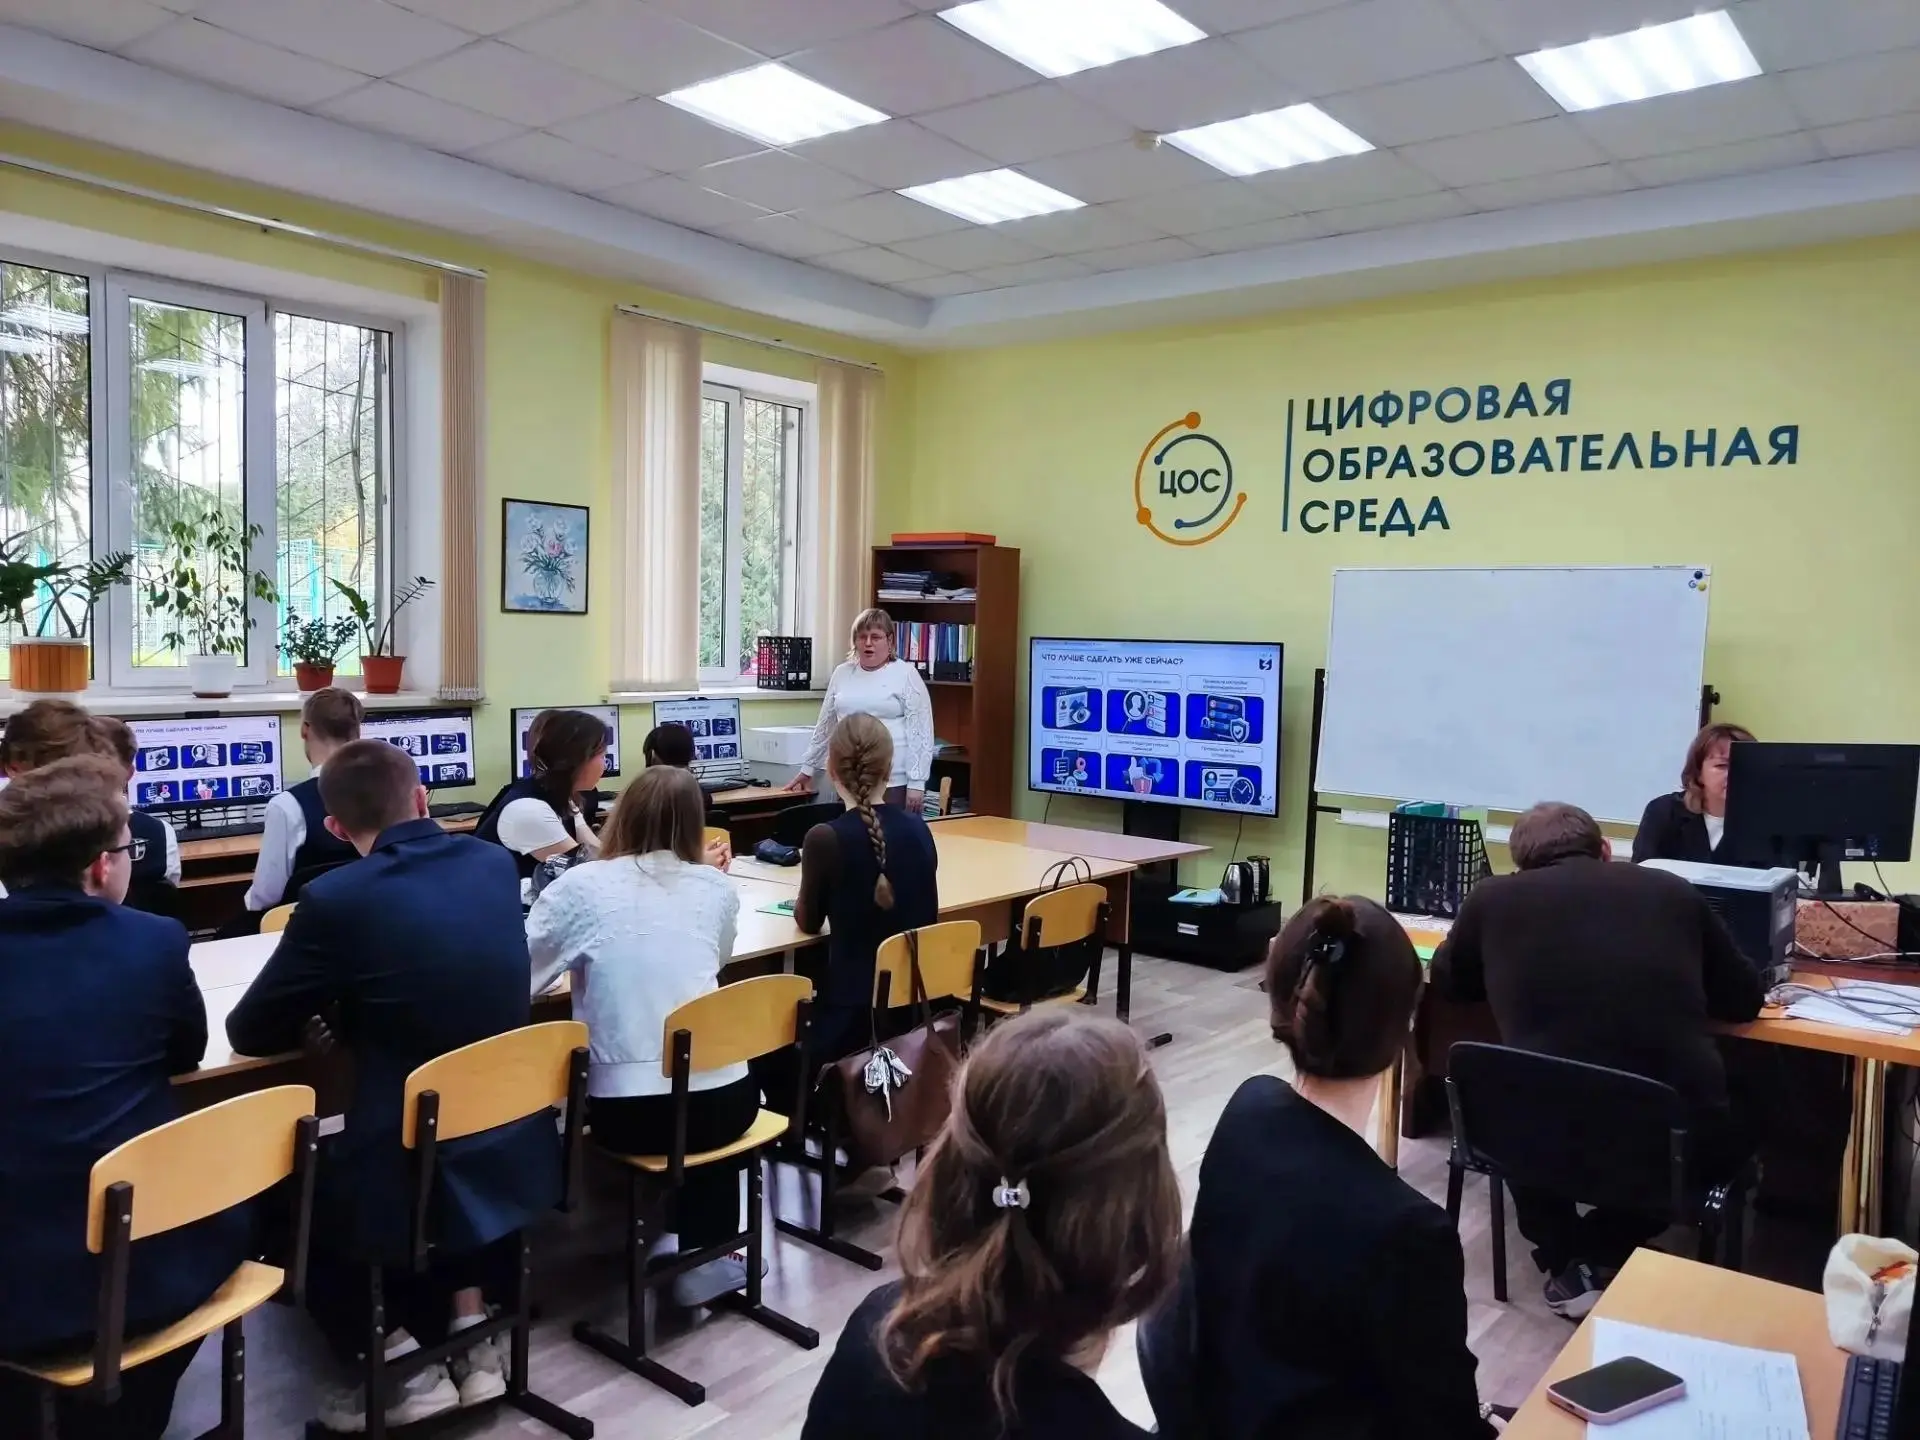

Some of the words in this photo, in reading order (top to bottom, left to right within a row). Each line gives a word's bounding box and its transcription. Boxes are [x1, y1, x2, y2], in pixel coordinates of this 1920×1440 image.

[1306, 379, 1571, 436] ЦИФРОВАЯ
[1303, 425, 1799, 482] ОБРАЗОВАТЕЛЬНАЯ
[1159, 468, 1221, 497] ЦОС
[1300, 496, 1450, 537] СРЕДА
[1042, 653, 1056, 661] ЧТО
[1058, 654, 1085, 662] ЛУЧШЕ
[1086, 655, 1123, 663] СДЕЛАТЬ
[1125, 656, 1142, 664] УЖЕ
[1144, 656, 1184, 665] СЕЙЧАС?
